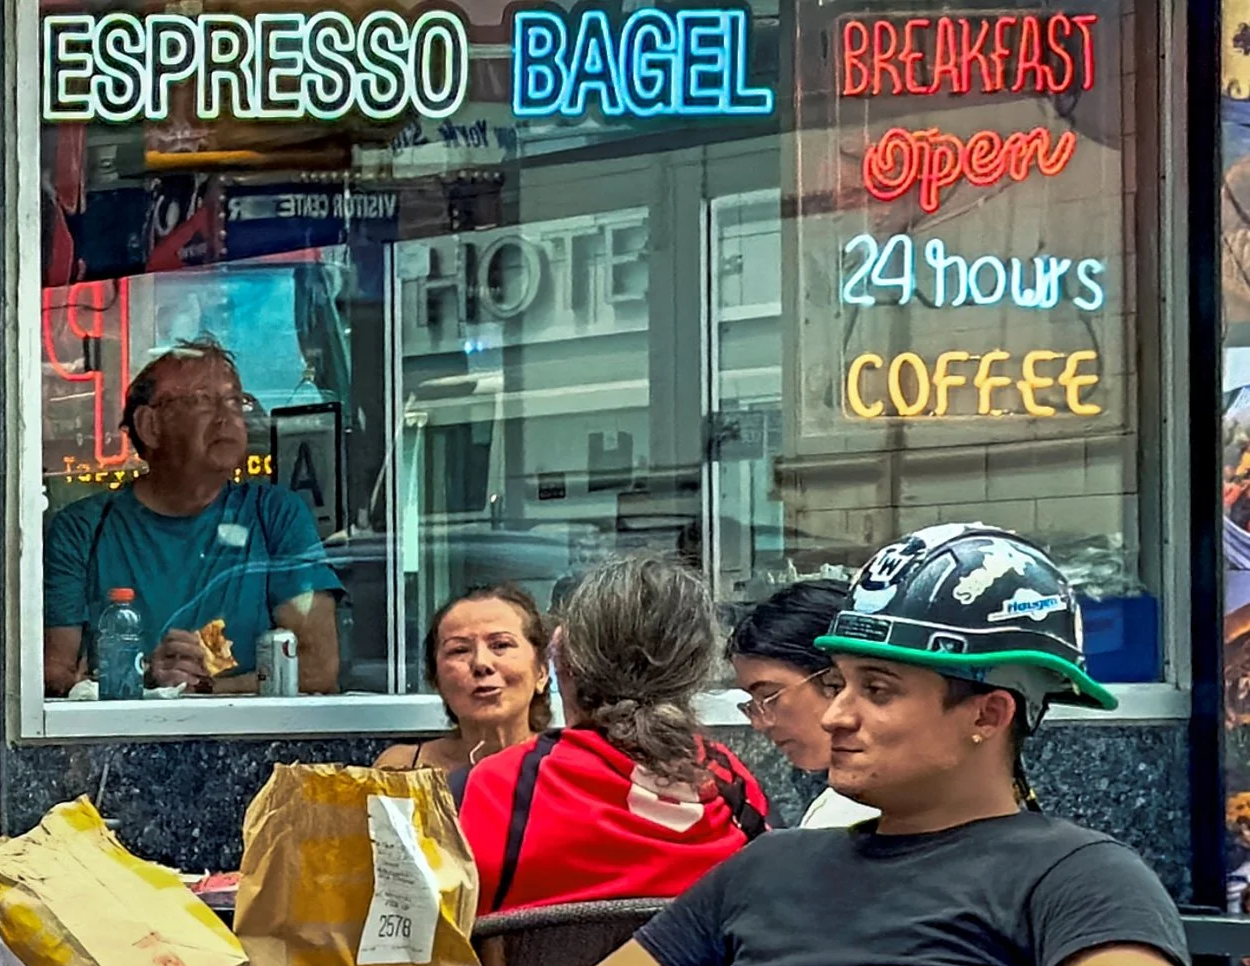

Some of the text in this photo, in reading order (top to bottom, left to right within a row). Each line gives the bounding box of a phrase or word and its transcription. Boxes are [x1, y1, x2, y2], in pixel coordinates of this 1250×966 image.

[43, 8, 775, 121] ESPRESSO BAGEL
[842, 13, 1098, 97] BREAKFAST
[862, 126, 1077, 214] Open
[843, 233, 1106, 312] 24 hours
[845, 349, 1102, 419] COFFEE
[378, 914, 412, 938] 2578
